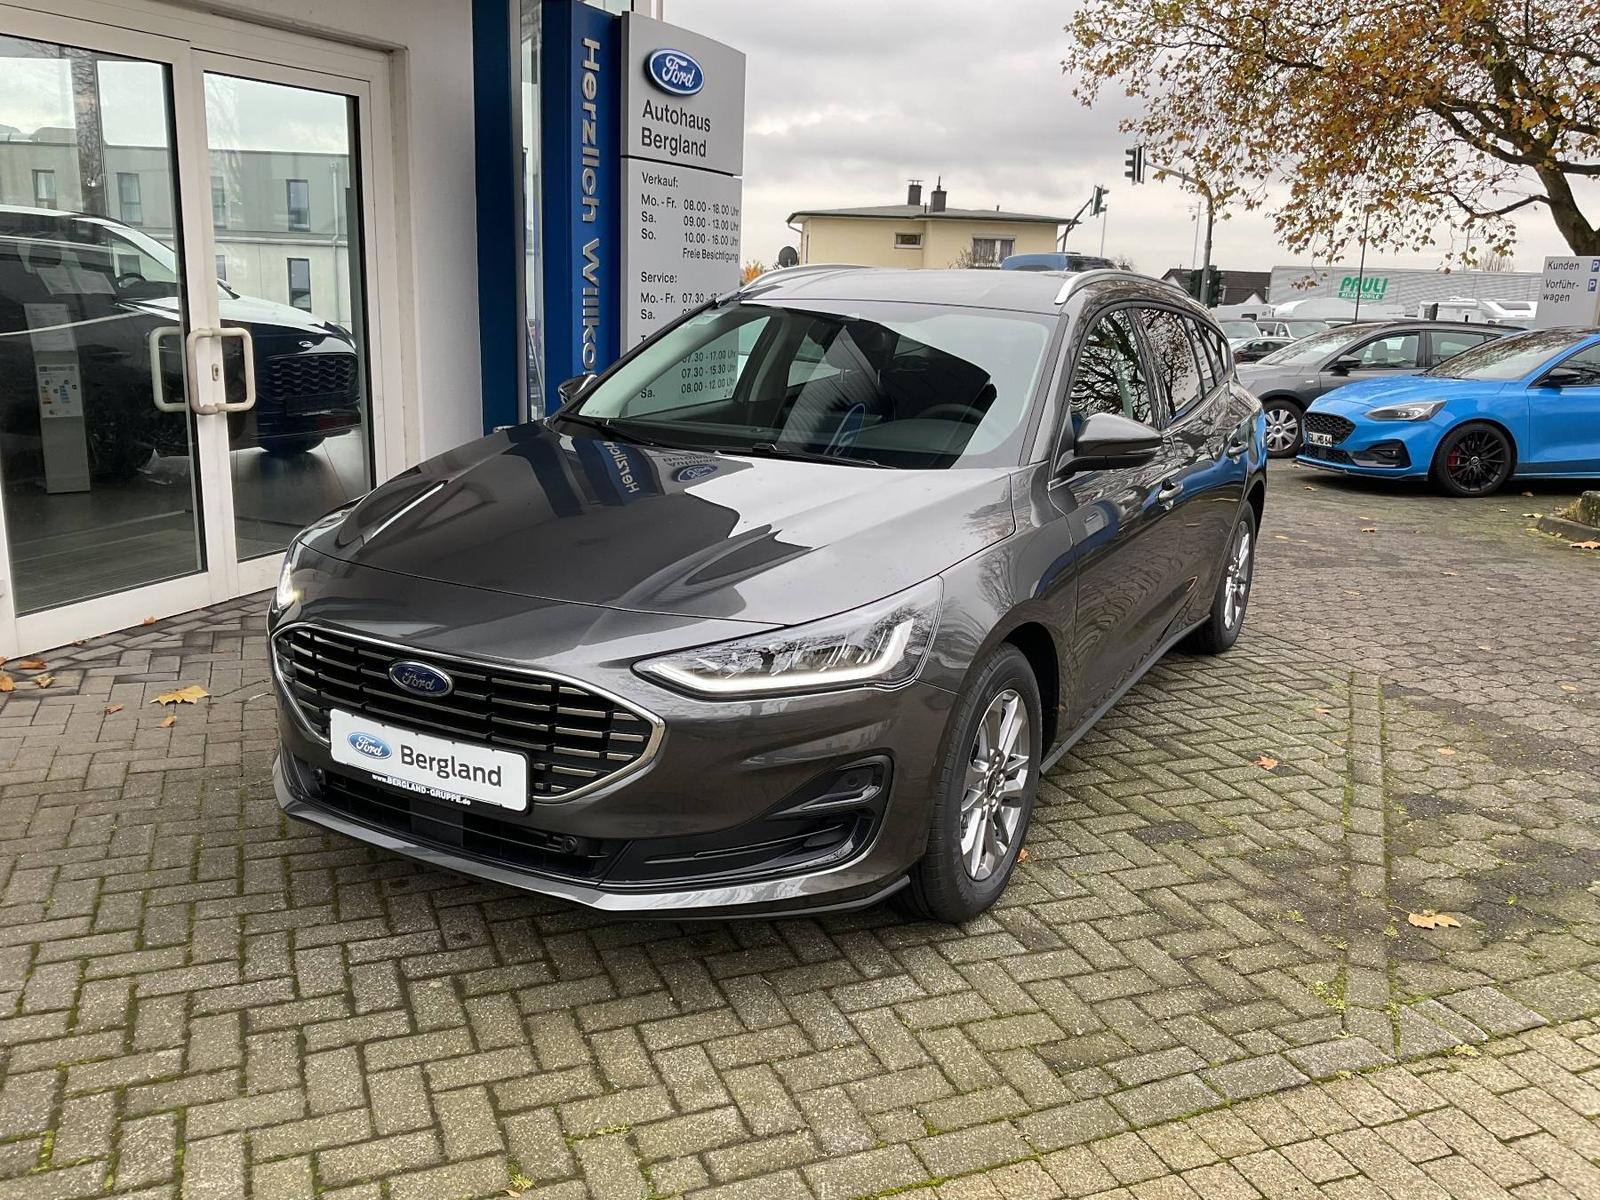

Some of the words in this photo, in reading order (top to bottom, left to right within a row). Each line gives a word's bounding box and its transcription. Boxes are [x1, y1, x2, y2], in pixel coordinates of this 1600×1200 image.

[661, 55, 695, 88] Ford
[642, 99, 711, 133] Autohaus
[582, 37, 600, 222] Herzlich
[641, 126, 707, 158] Bergland
[641, 171, 679, 188] Verkauf:
[641, 193, 659, 207] Mo.
[666, 196, 677, 209] Fr.
[683, 199, 707, 212] 08.00
[712, 203, 730, 216] 18.00
[730, 205, 739, 217] Uhr
[641, 211, 656, 223] Sa.
[683, 215, 706, 228] 09.00
[712, 219, 729, 231] 13.00
[730, 221, 739, 231] Uhr
[641, 228, 656, 240] So.
[684, 232, 706, 244] 10.00
[712, 234, 729, 246] 16.00
[730, 236, 739, 246] Uhr
[682, 247, 701, 259] Freie
[701, 248, 739, 263] Besichtigung
[1547, 260, 1580, 271] Kunden
[640, 271, 678, 284] Service:
[1545, 278, 1580, 290] Vorführ-
[582, 238, 600, 375] Willko
[640, 292, 659, 304] Mo.
[665, 292, 676, 304] Fr.
[682, 292, 705, 304] 07.30
[1543, 293, 1570, 303] wagen
[640, 308, 656, 320] Sa.
[681, 366, 704, 379] 07.30
[710, 364, 726, 376] 15.30
[640, 388, 656, 399] Sa.
[681, 381, 704, 394] 08.00
[401, 667, 436, 692] Ford
[355, 735, 384, 757] Ford
[400, 743, 502, 788] Bergland
